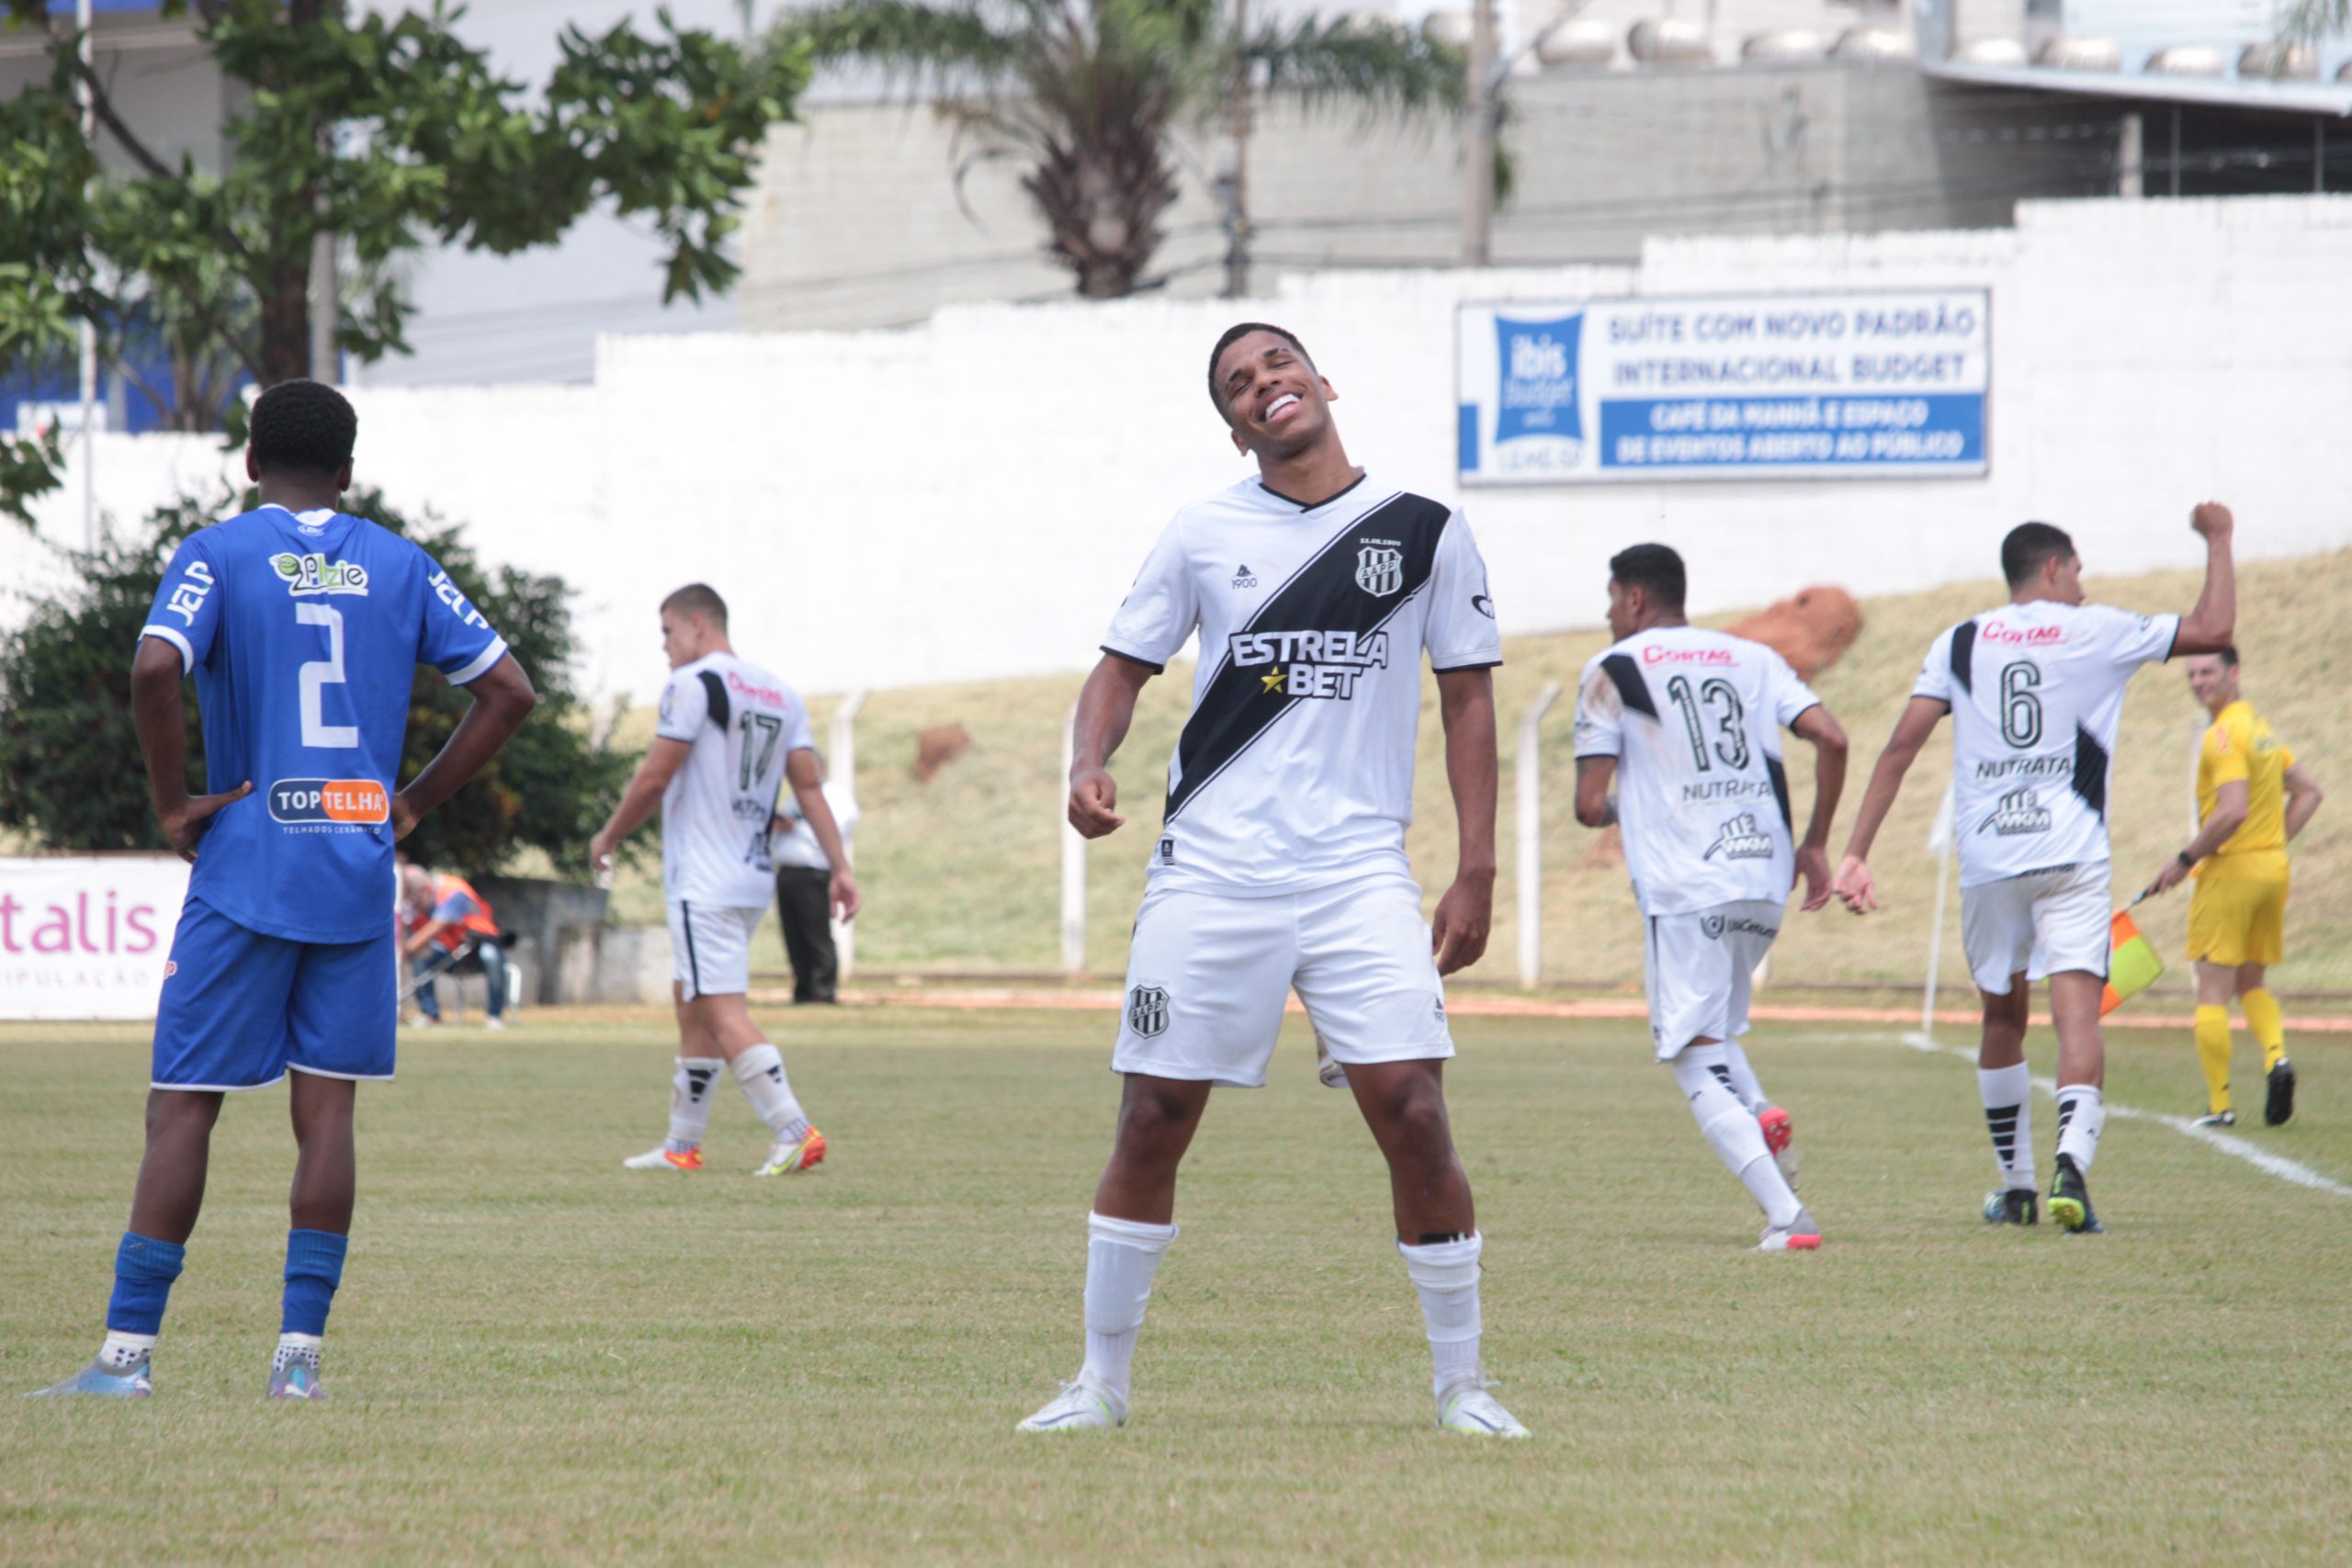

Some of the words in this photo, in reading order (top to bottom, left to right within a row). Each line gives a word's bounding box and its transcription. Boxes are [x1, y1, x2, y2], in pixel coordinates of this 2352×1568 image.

[1696, 310, 1756, 342] COM
[1764, 309, 1845, 340] NOVO
[1856, 300, 1975, 338] PADRÃO
[1510, 333, 1567, 379] ibis
[1614, 355, 1840, 385] INTERNACIONAL
[1852, 352, 1964, 382] BUDGET
[1711, 402, 1740, 430] DA
[1824, 400, 1839, 428] E
[1617, 436, 1646, 463] DE
[1648, 434, 1745, 462] EVENTOS
[1748, 432, 1834, 460] ABERTO
[1836, 431, 1870, 459] AO
[1231, 577, 1258, 591] 1900
[1362, 560, 1396, 578] AAPP
[1228, 629, 1388, 669] ESTRELA
[295, 602, 359, 749] 2
[1287, 663, 1363, 700] BET
[2000, 660, 2043, 750] 6
[1667, 675, 1750, 773] 13
[740, 709, 784, 792] 17
[1975, 756, 2074, 780] NUTRATA
[1682, 778, 1772, 803] NUTRATA
